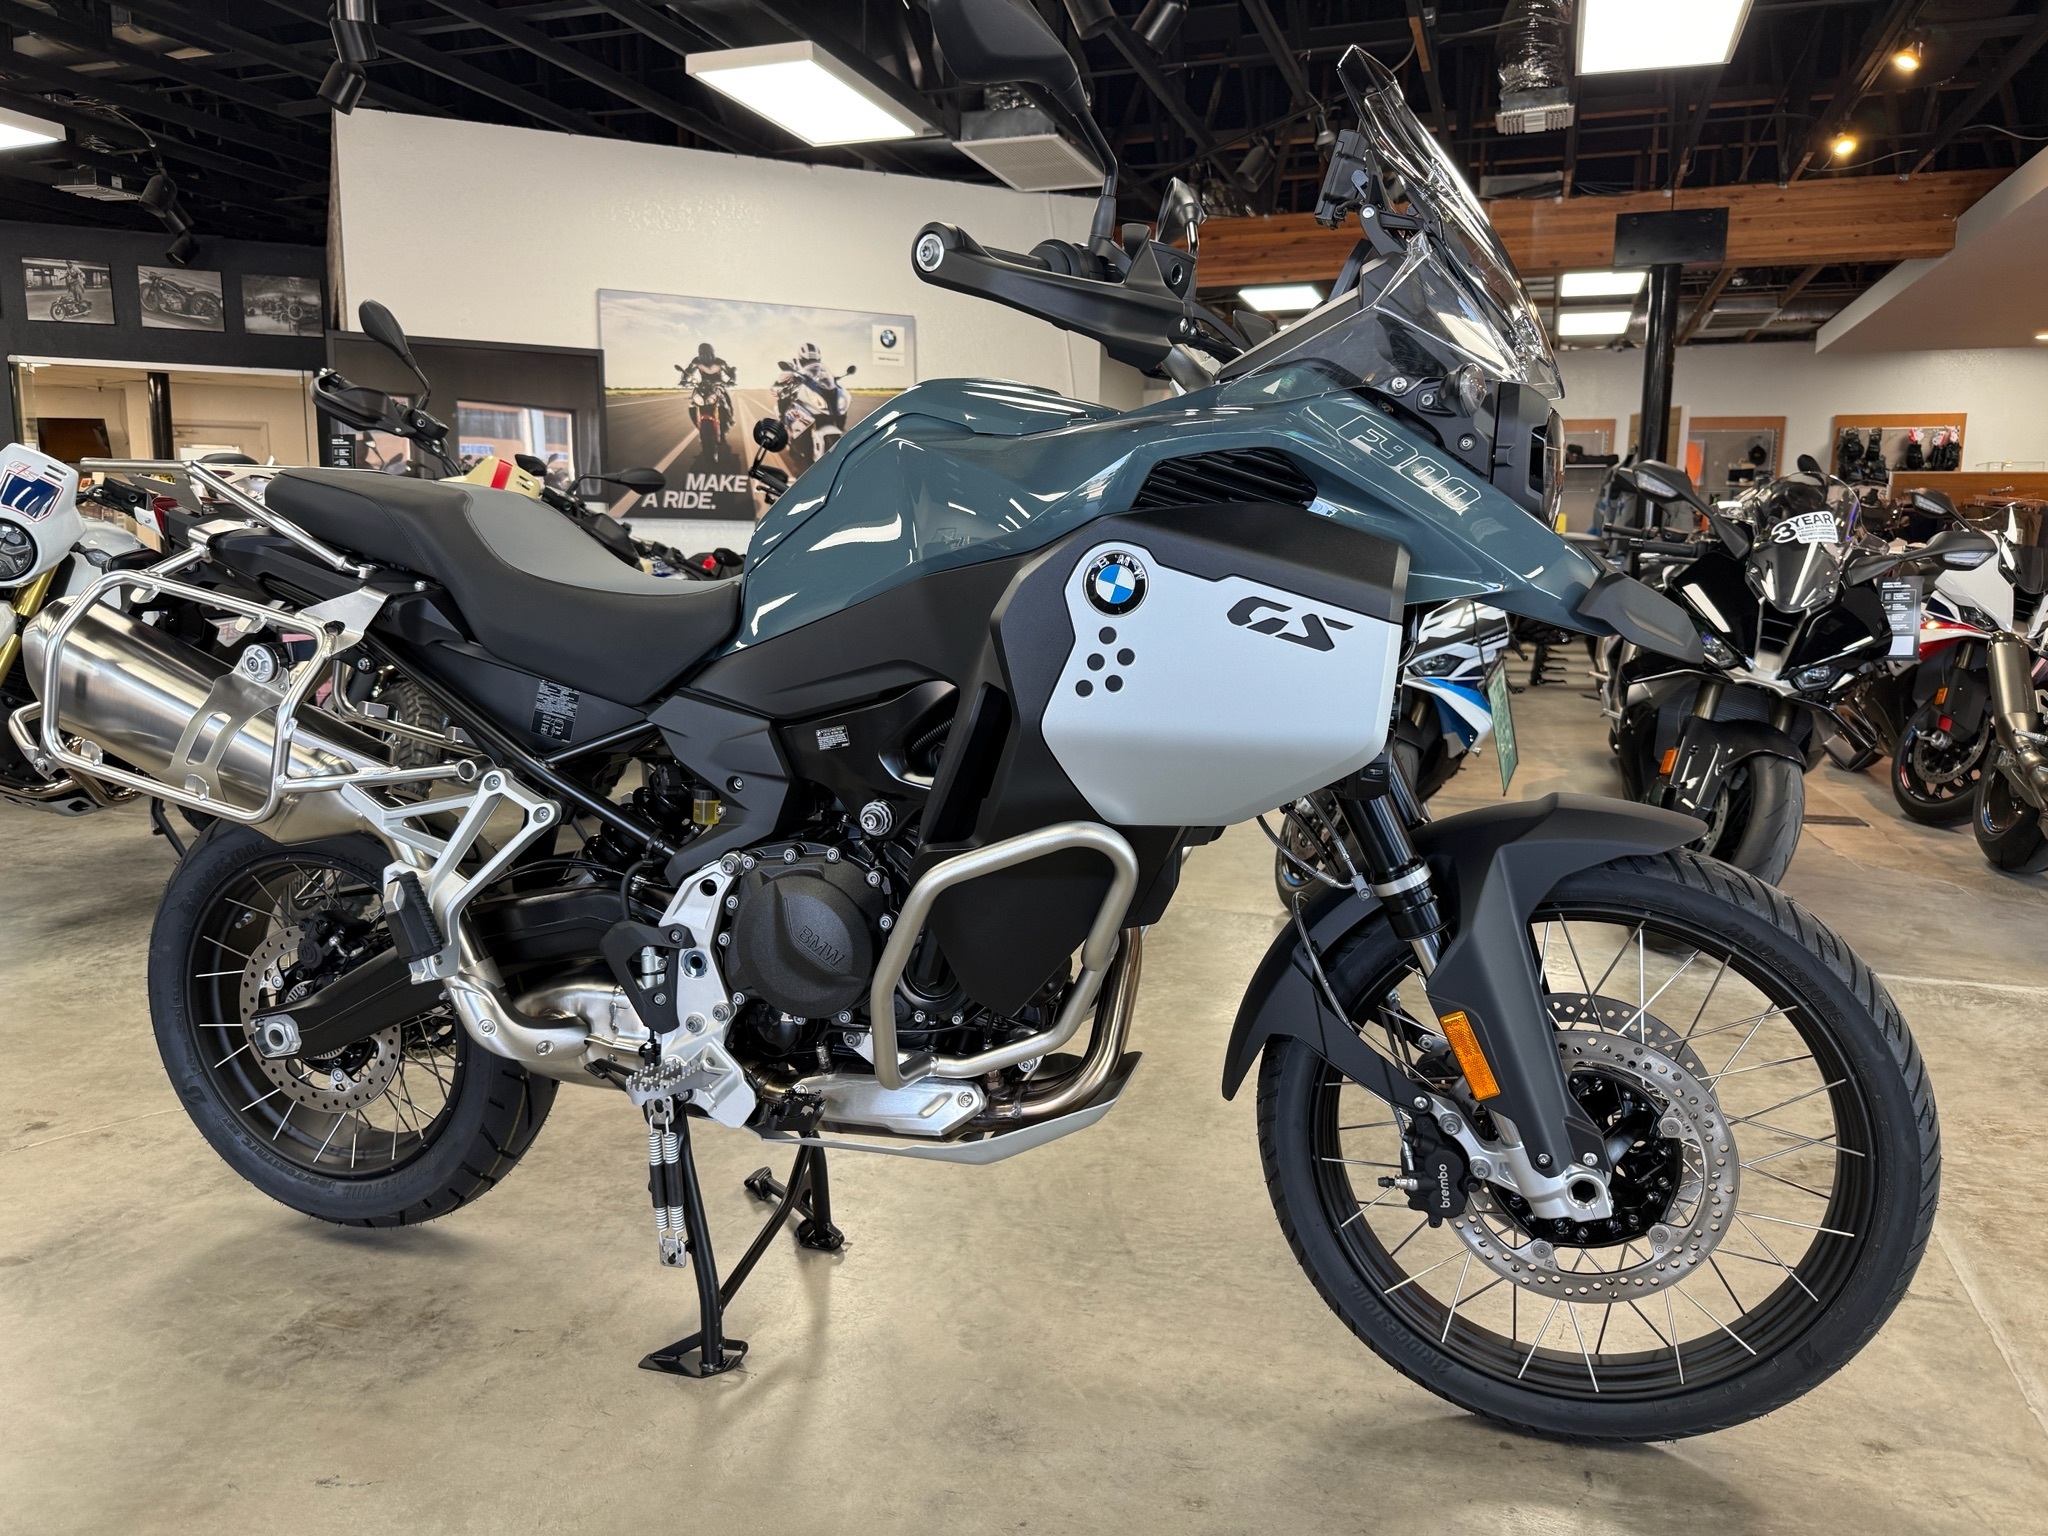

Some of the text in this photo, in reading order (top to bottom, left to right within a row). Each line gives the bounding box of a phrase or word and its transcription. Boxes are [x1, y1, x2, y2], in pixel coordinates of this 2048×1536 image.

[685, 473, 749, 492] MAKE
[1336, 415, 1481, 514] F900
[641, 490, 716, 510] A RIDE.
[1773, 523, 1797, 541] 3
[1790, 513, 1833, 527] YEAR
[1097, 554, 1146, 580] BMW
[1227, 596, 1354, 652] GS
[799, 925, 846, 966] BMW
[1722, 922, 1847, 1024] BRIDGESTONE
[1437, 1163, 1450, 1209] brembo
[1345, 1279, 1455, 1375] BRIDGESTONE
